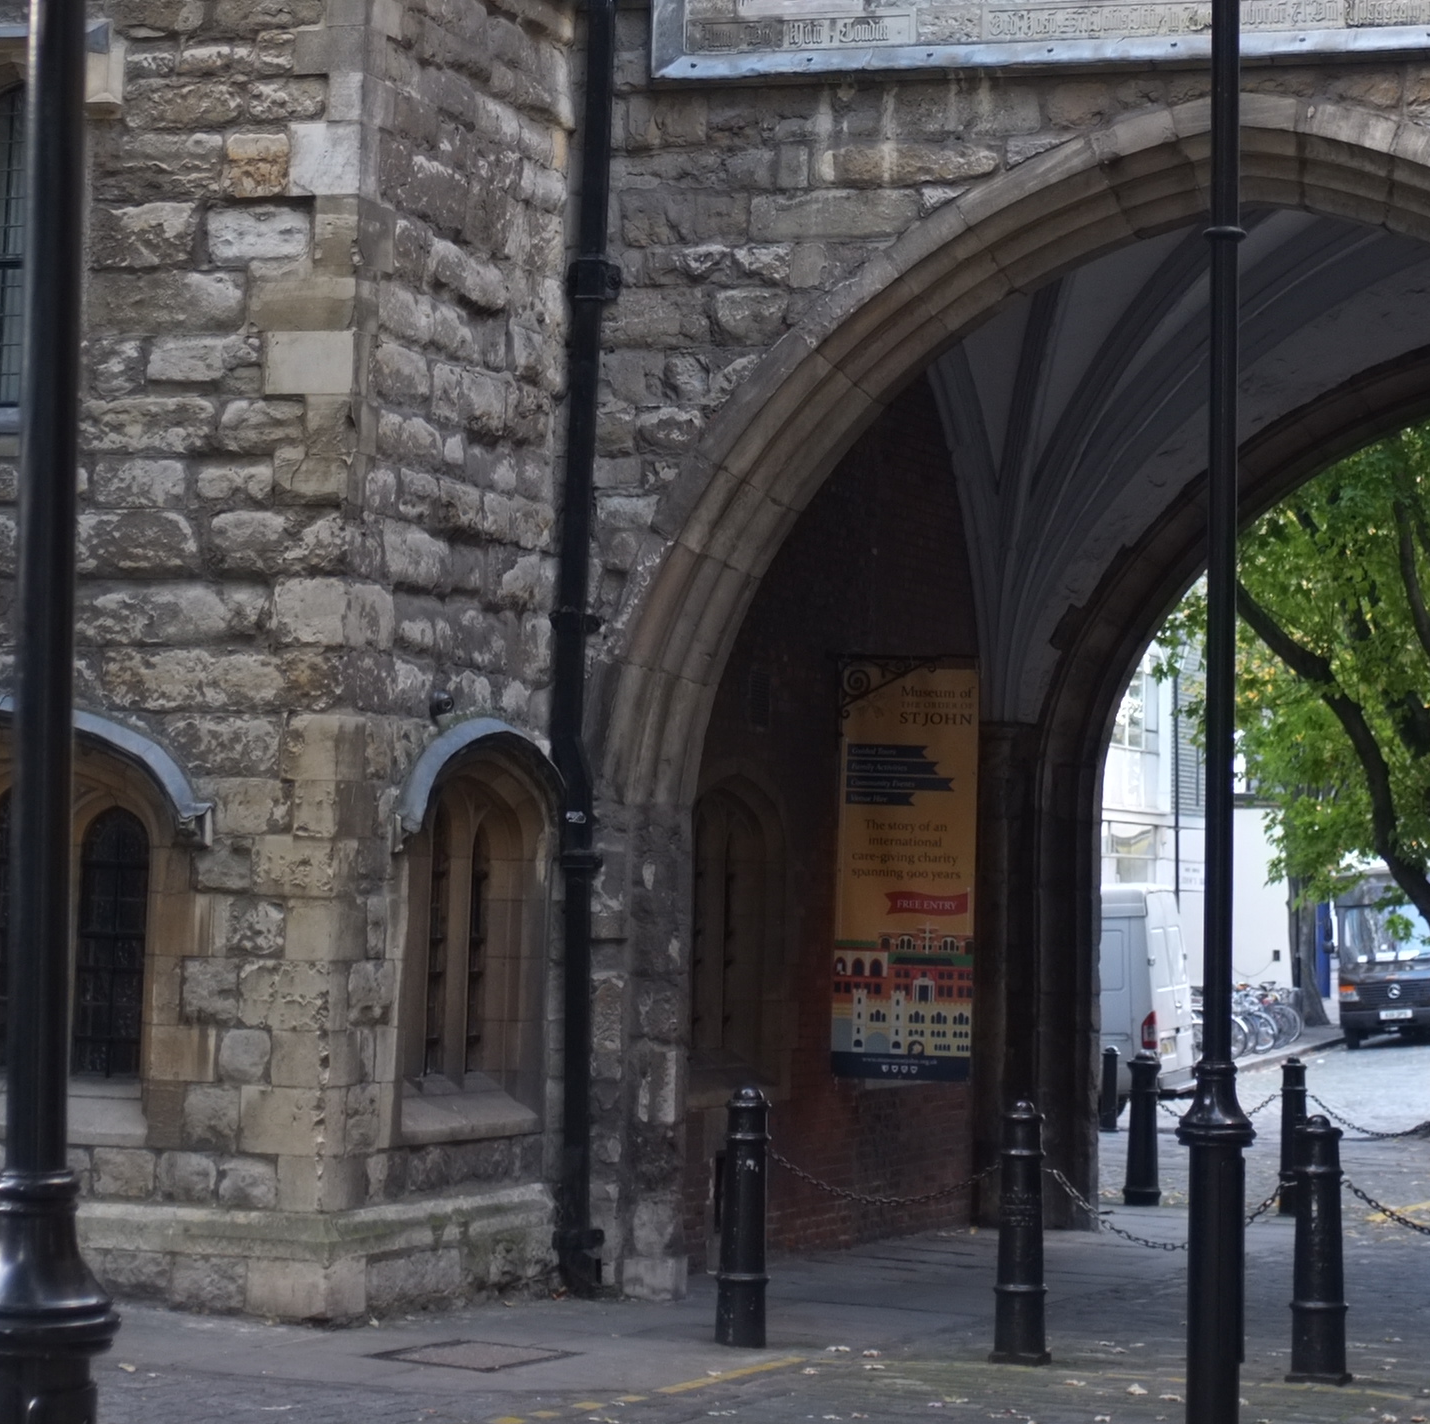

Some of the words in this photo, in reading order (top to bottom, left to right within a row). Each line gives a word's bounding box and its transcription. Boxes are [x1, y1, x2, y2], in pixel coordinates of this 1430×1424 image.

[901, 685, 955, 699] Museum
[960, 686, 976, 698] of
[901, 701, 920, 709] THE
[923, 701, 957, 709] ORDER
[960, 701, 974, 709] OF
[851, 747, 876, 755] Guided
[851, 762, 874, 772] Family
[876, 764, 908, 772] Activities
[850, 778, 891, 788] Community
[892, 779, 915, 788] Events
[864, 819, 886, 831] The
[888, 821, 915, 834] story
[919, 820, 931, 832] of
[933, 823, 948, 832] an
[868, 835, 942, 847] international
[851, 852, 915, 865] care-giving
[917, 852, 958, 866] charity
[851, 867, 903, 880] spanning
[906, 871, 929, 879] 900
[931, 872, 961, 881] years
[896, 899, 922, 909] FREE
[923, 900, 956, 910] ENTRY
